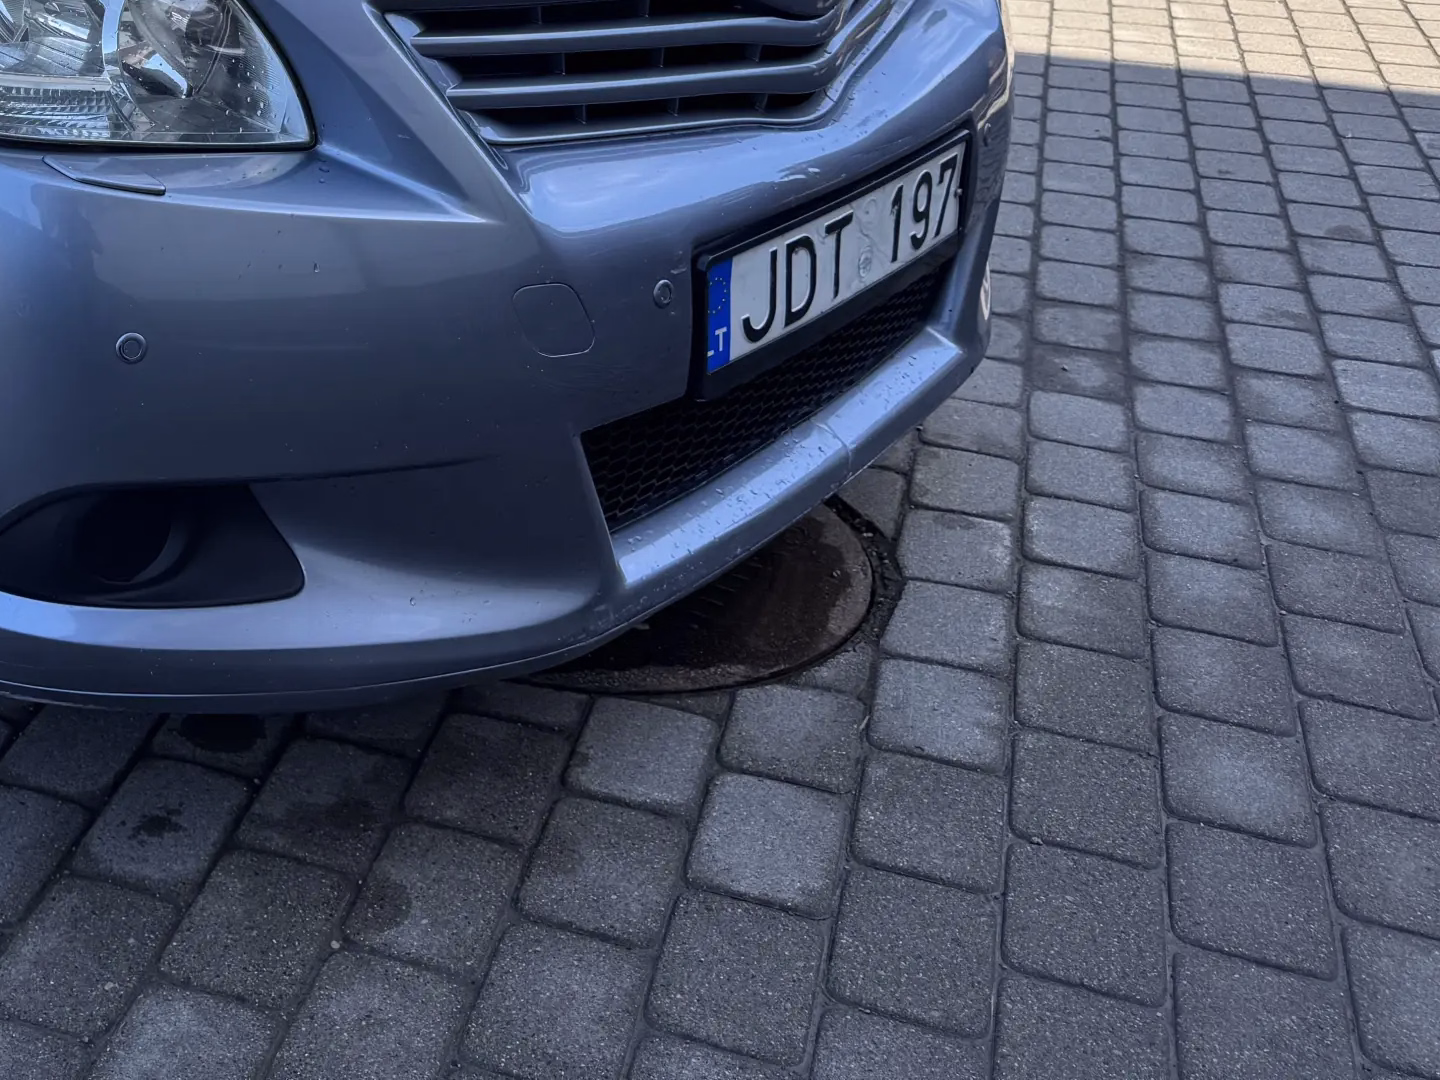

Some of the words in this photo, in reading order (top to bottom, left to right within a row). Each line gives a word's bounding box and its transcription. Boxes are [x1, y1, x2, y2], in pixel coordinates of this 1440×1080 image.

[742, 210, 854, 344] JDT
[889, 153, 959, 264] 197
[707, 327, 728, 358] T
